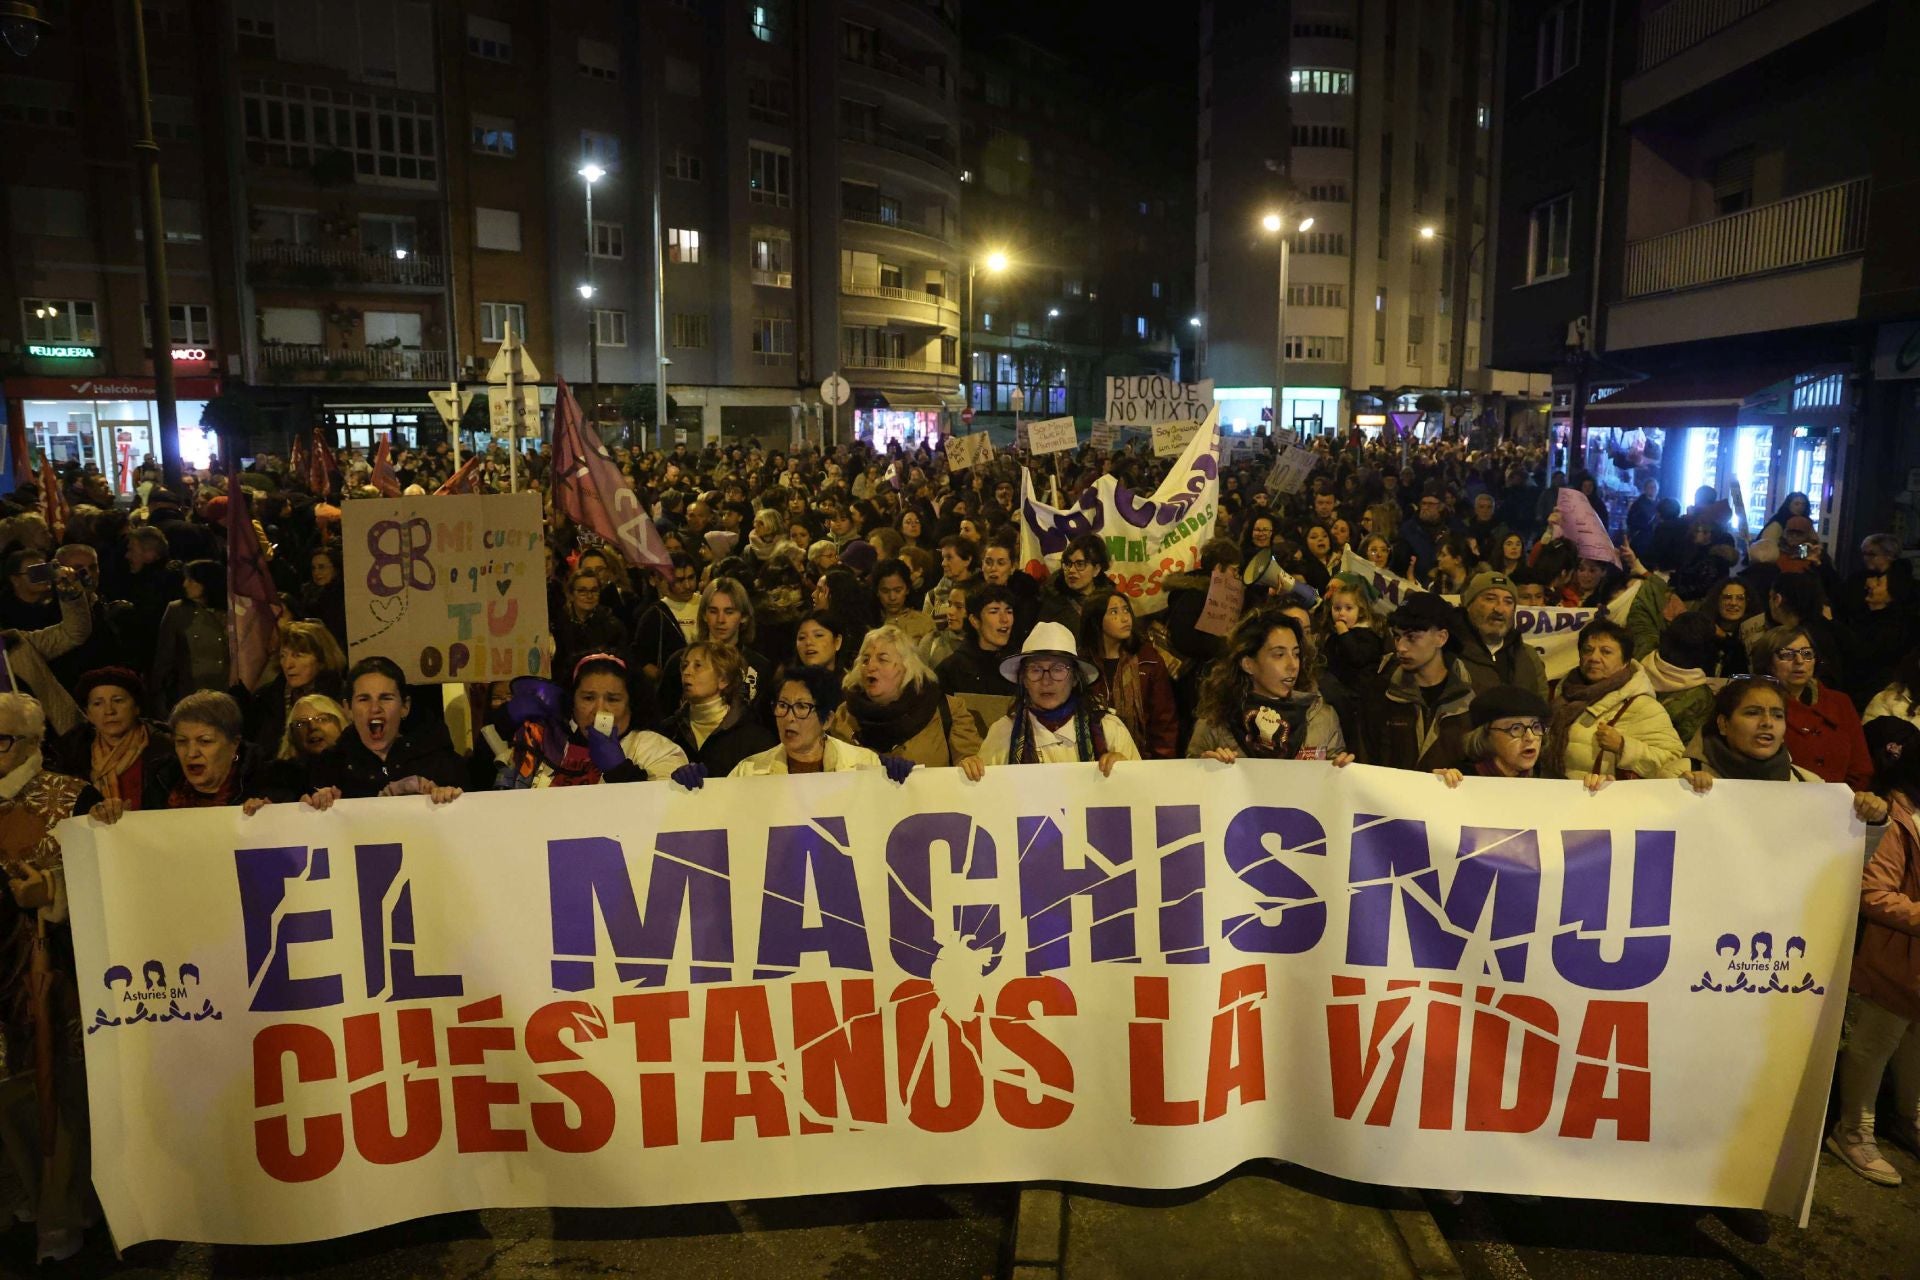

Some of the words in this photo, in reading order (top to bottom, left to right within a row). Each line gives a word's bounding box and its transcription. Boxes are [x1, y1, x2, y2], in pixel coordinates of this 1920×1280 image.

[93, 384, 138, 395] Halcón
[1113, 376, 1199, 401] BLOQUE
[1110, 402, 1137, 422] NO
[1145, 400, 1208, 425] MIXTO
[447, 598, 519, 641] TU
[234, 842, 464, 1012] EL
[547, 803, 1676, 992] MACHISMU
[1728, 960, 1770, 971] Asturies
[1773, 960, 1790, 971] 8M
[123, 988, 167, 1002] Asturies
[170, 987, 188, 999] 8M
[253, 976, 1079, 1183] CUÉSTANOS
[1127, 963, 1268, 1127] LA
[1325, 975, 1652, 1143] VIDA
